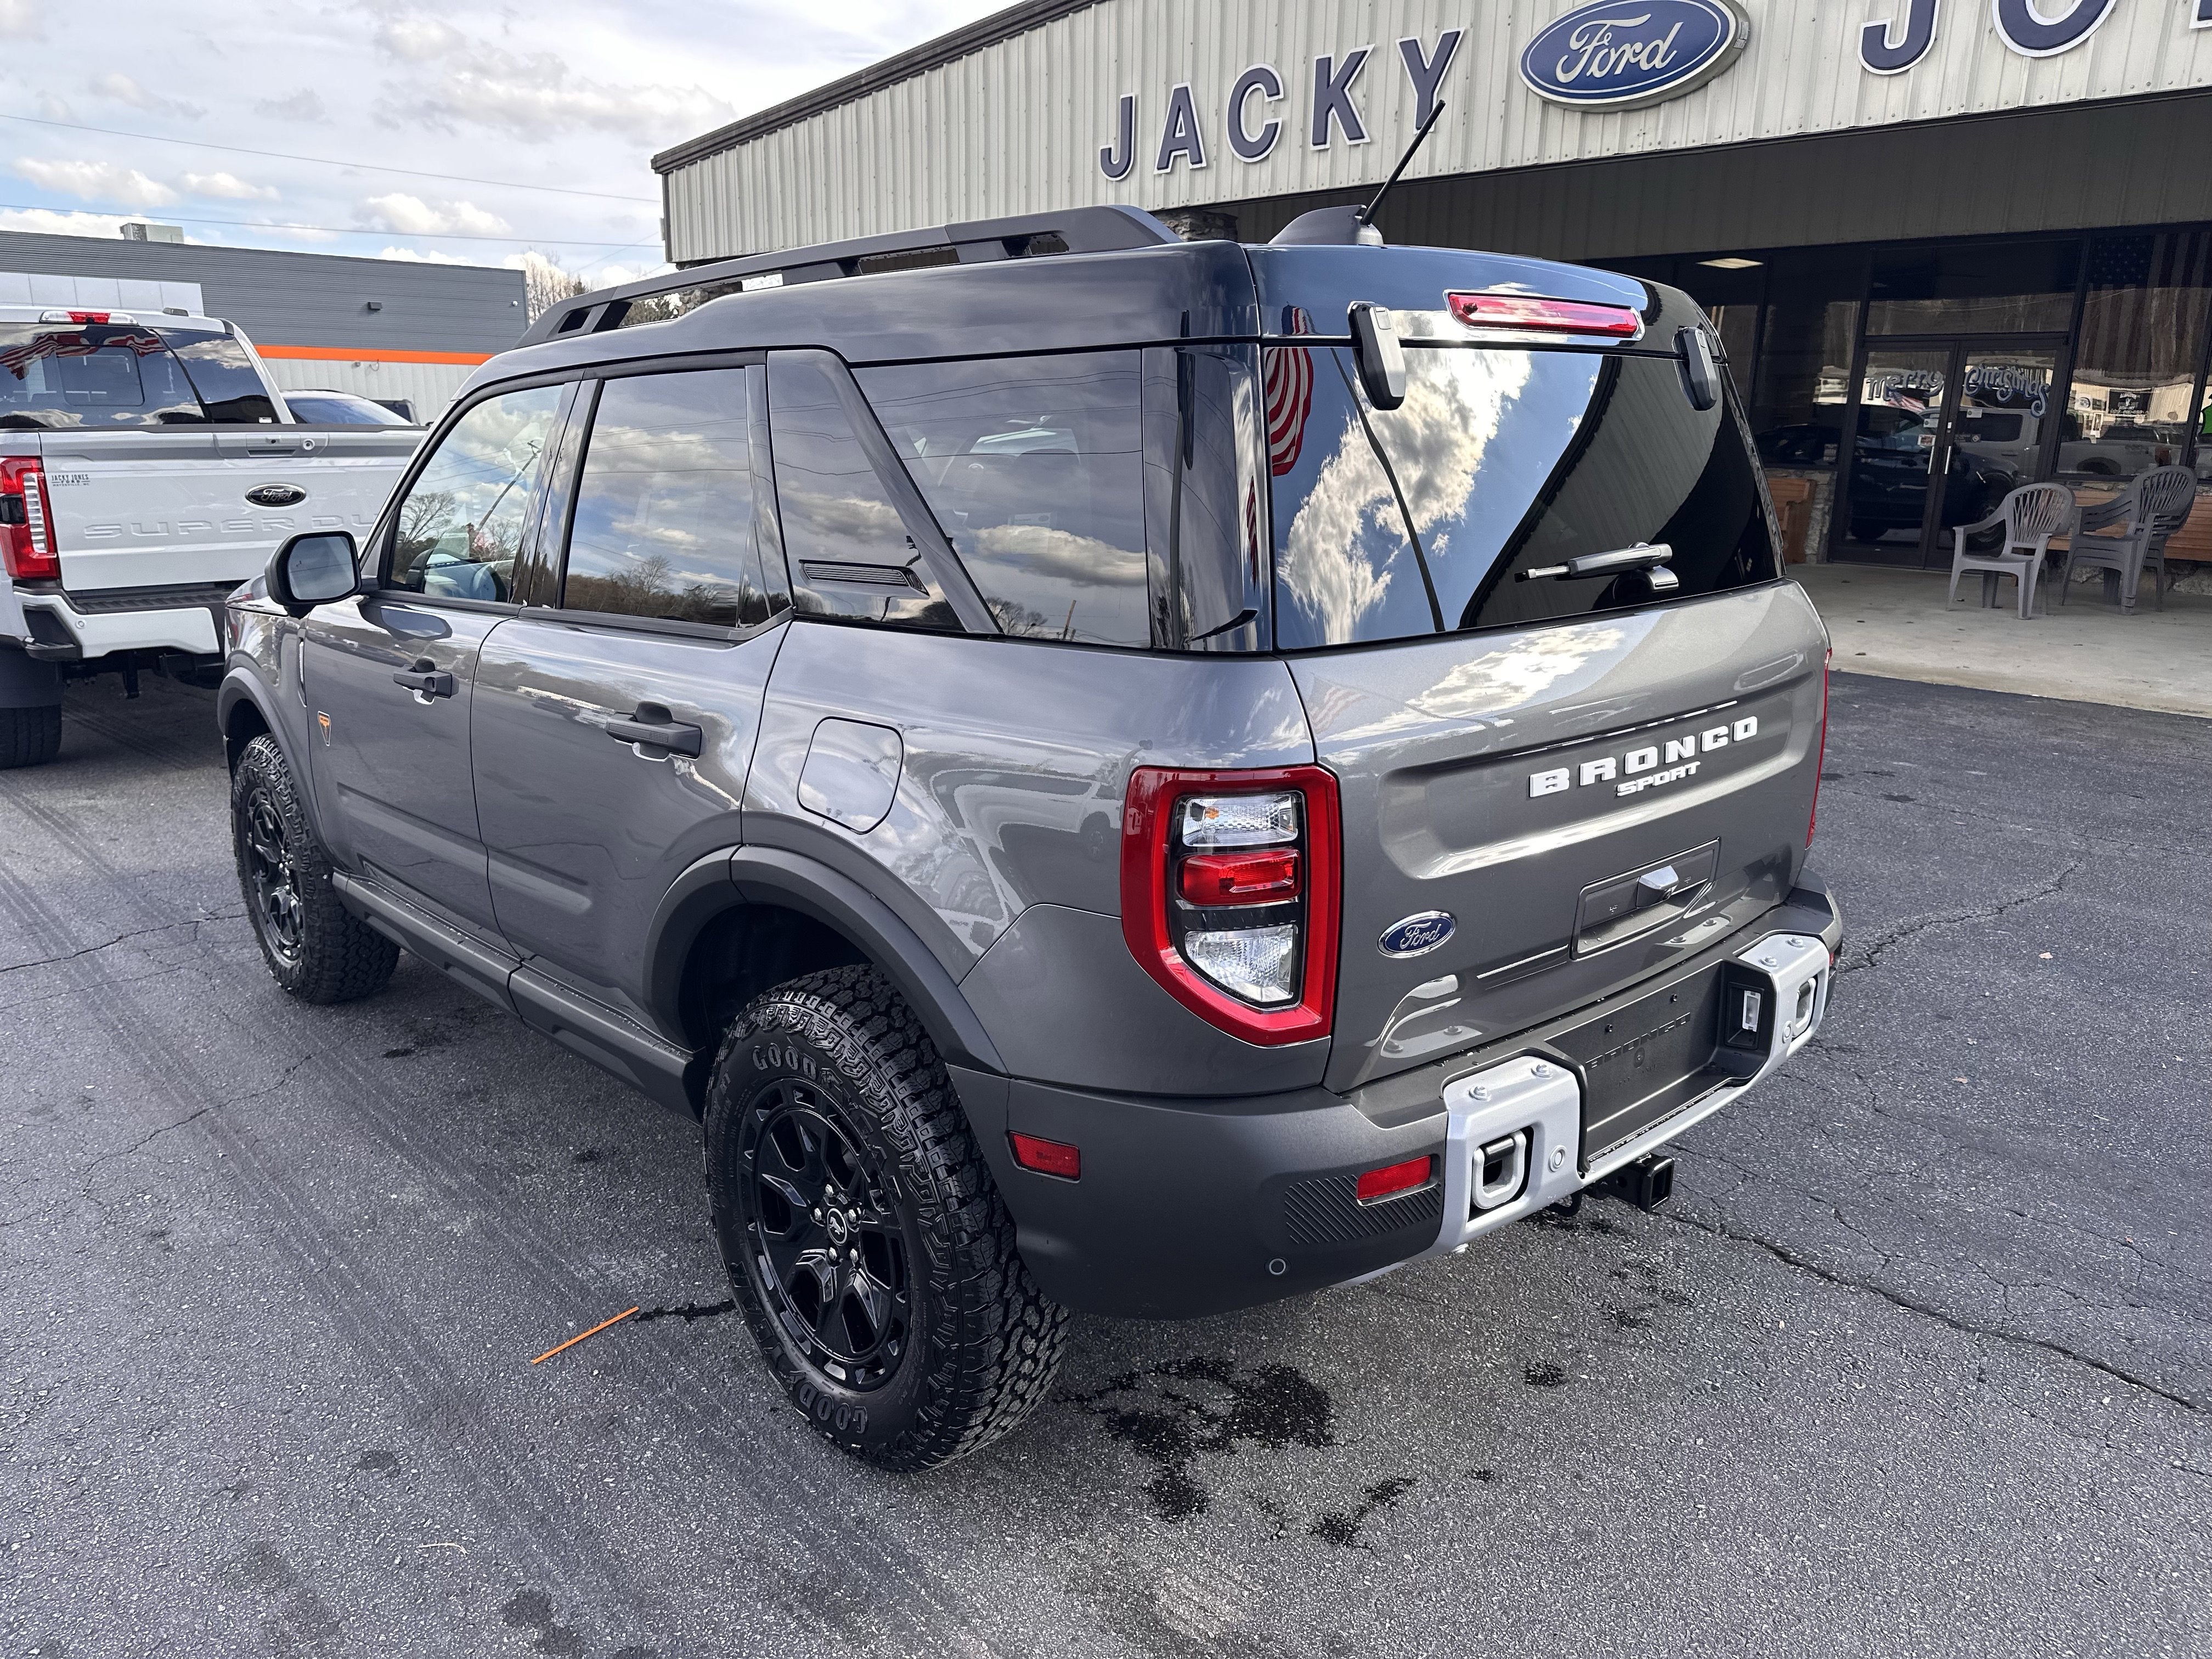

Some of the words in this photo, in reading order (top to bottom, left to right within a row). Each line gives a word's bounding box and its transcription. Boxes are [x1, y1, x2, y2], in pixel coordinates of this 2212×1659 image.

[1556, 14, 1684, 83] Ford
[1099, 26, 1465, 181] JACKY
[1964, 363, 2050, 418] Christmas
[261, 488, 292, 501] Ford
[84, 517, 295, 539] SUPER
[1530, 716, 1758, 798] BRONCO
[1616, 761, 1700, 797] SPORT
[1400, 922, 1441, 950] Ford
[1585, 1012, 1691, 1071] BRONCO
